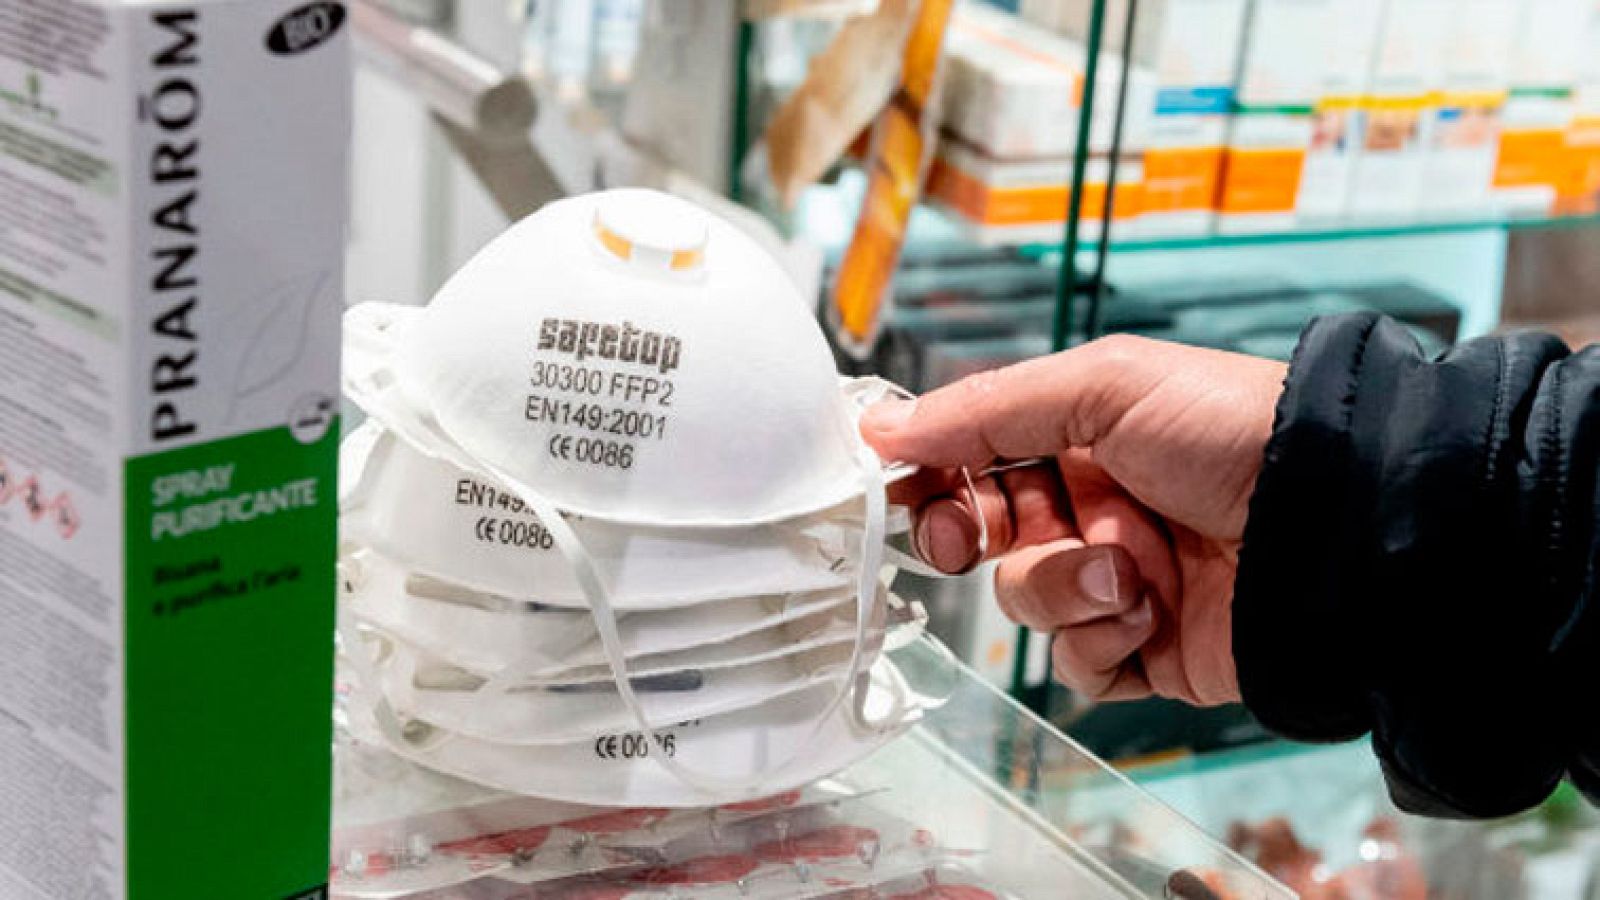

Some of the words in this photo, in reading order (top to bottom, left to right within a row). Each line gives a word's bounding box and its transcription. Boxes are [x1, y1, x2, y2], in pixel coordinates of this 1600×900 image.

[530, 361, 602, 395] 30300
[608, 372, 674, 406] FFP2
[526, 396, 665, 439] EN149:2001
[152, 464, 234, 506] SPRAY
